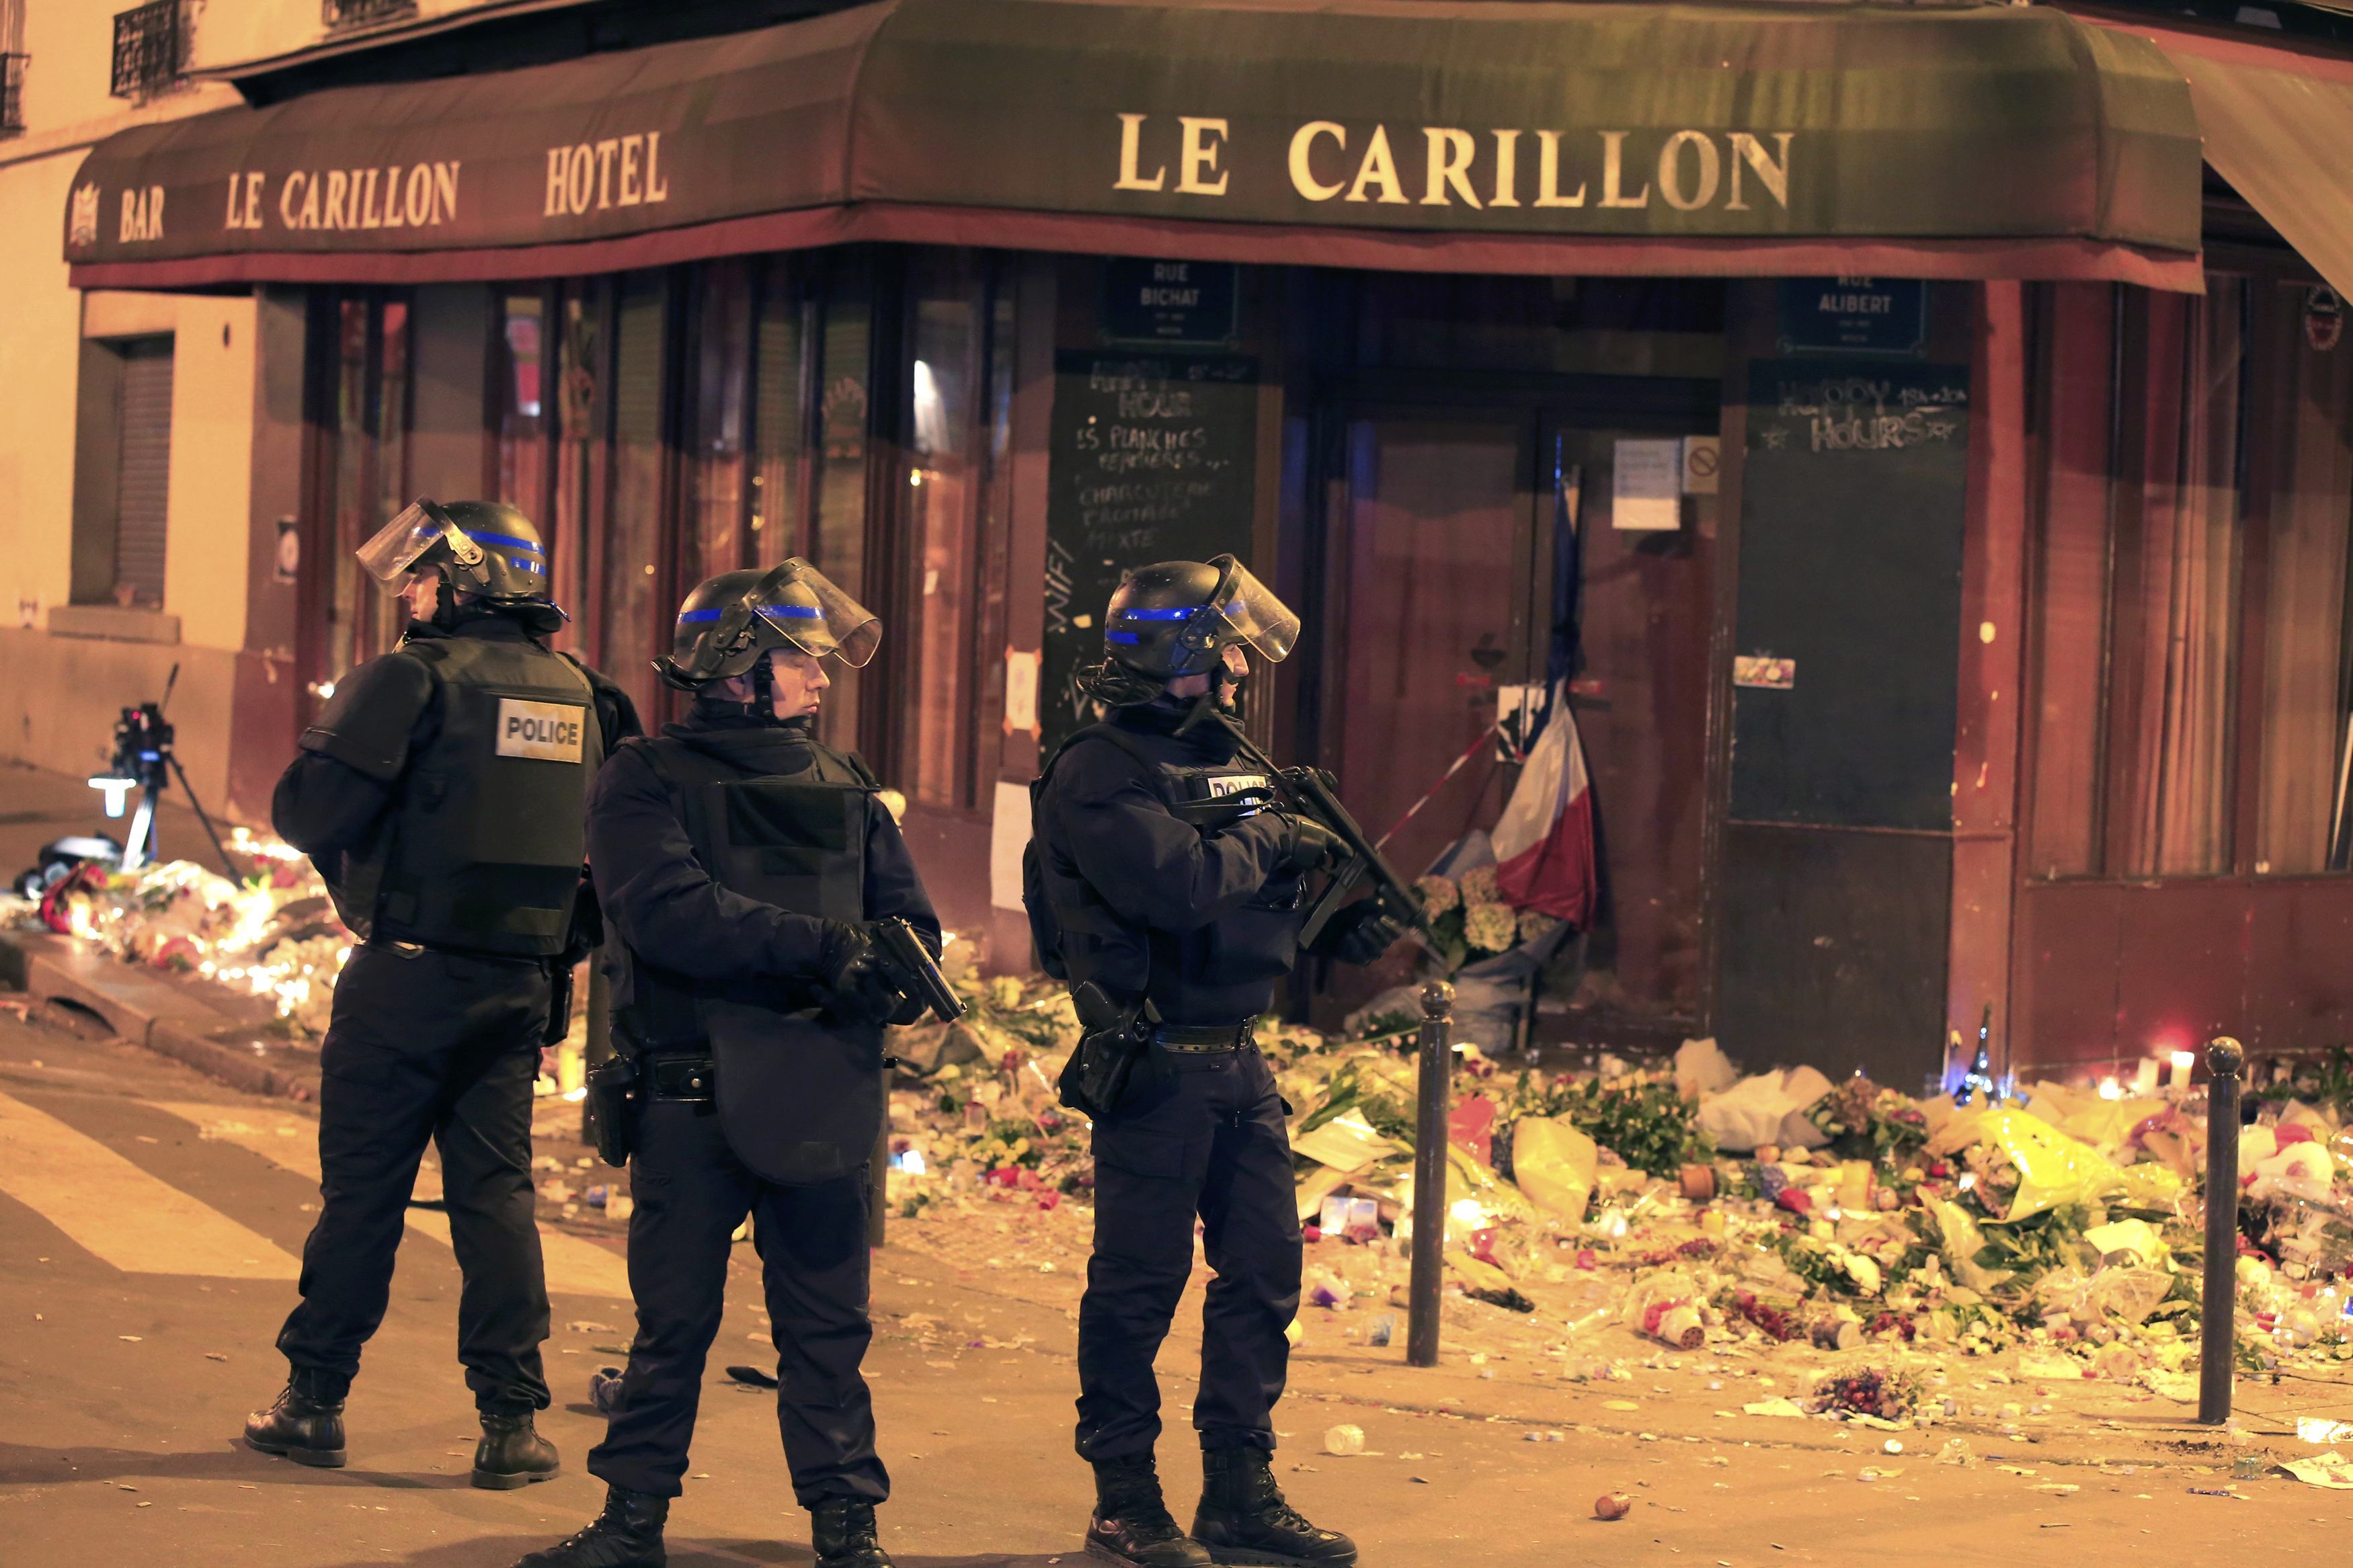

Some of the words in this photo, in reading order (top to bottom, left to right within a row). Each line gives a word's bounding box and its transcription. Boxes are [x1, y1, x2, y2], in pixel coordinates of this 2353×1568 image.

[543, 131, 668, 218] HOTEL
[1112, 112, 1230, 196] LE
[1287, 120, 1796, 214] CARILLON
[118, 184, 165, 244] BAR
[225, 171, 264, 231] LE
[279, 161, 461, 231] CARILLON
[1154, 263, 1189, 282] RUE
[1140, 287, 1201, 306] BICHAT
[1819, 293, 1892, 314] ALIBERT
[506, 716, 579, 746] POLICE
